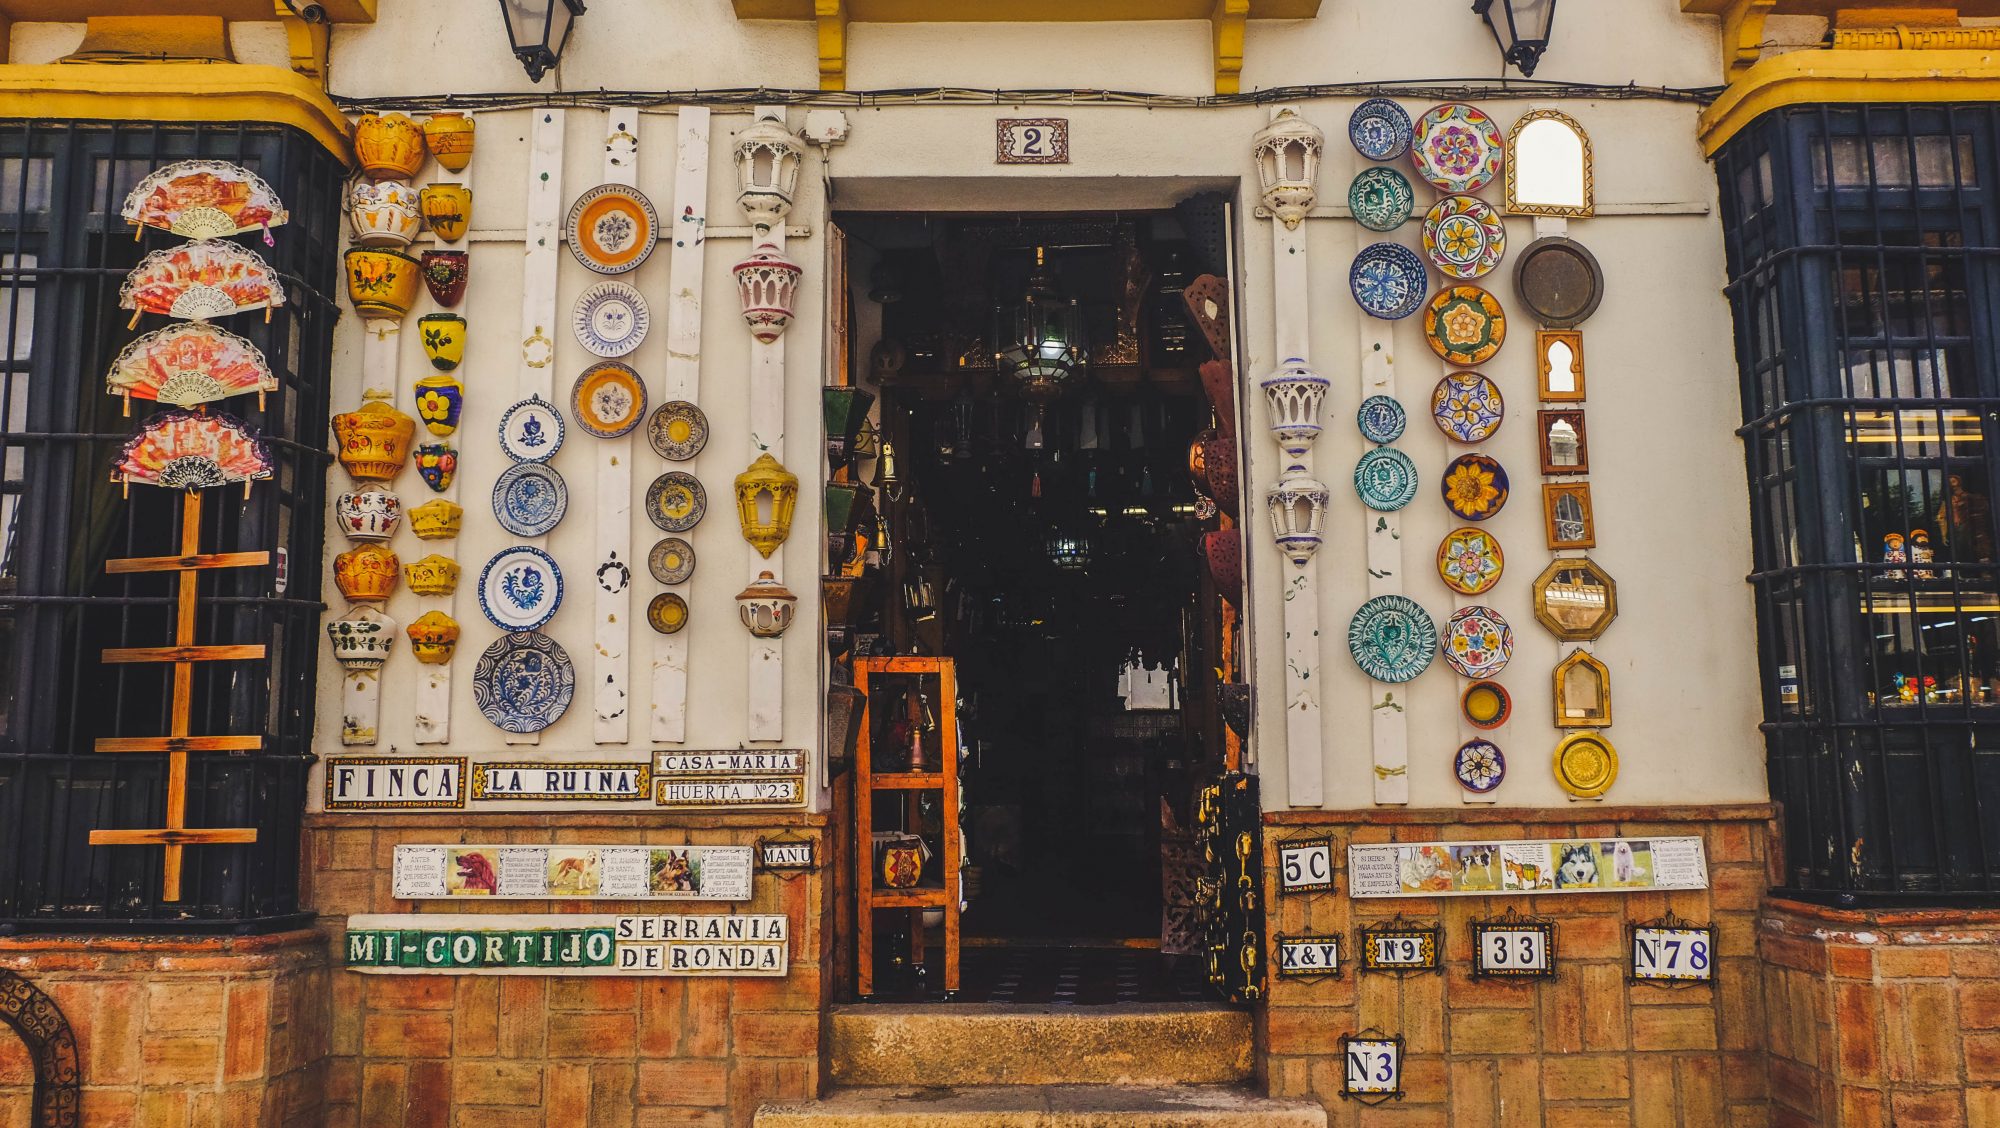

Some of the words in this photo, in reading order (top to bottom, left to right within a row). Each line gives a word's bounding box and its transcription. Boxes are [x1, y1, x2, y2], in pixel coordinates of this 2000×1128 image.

[1023, 127, 1042, 155] 2
[666, 755, 791, 770] CASA-MARIA
[338, 768, 453, 798] FINCA
[492, 771, 523, 791] LA
[545, 771, 631, 792] RUINA
[670, 785, 741, 800] HUERTA
[764, 848, 810, 863] MANU
[617, 918, 782, 939] SERRANIA
[349, 932, 611, 964] MI-CORTIJO
[622, 948, 658, 968] DE
[671, 947, 777, 968] RONDA
[1283, 945, 1334, 967] X&Y
[1493, 936, 1534, 965] 33
